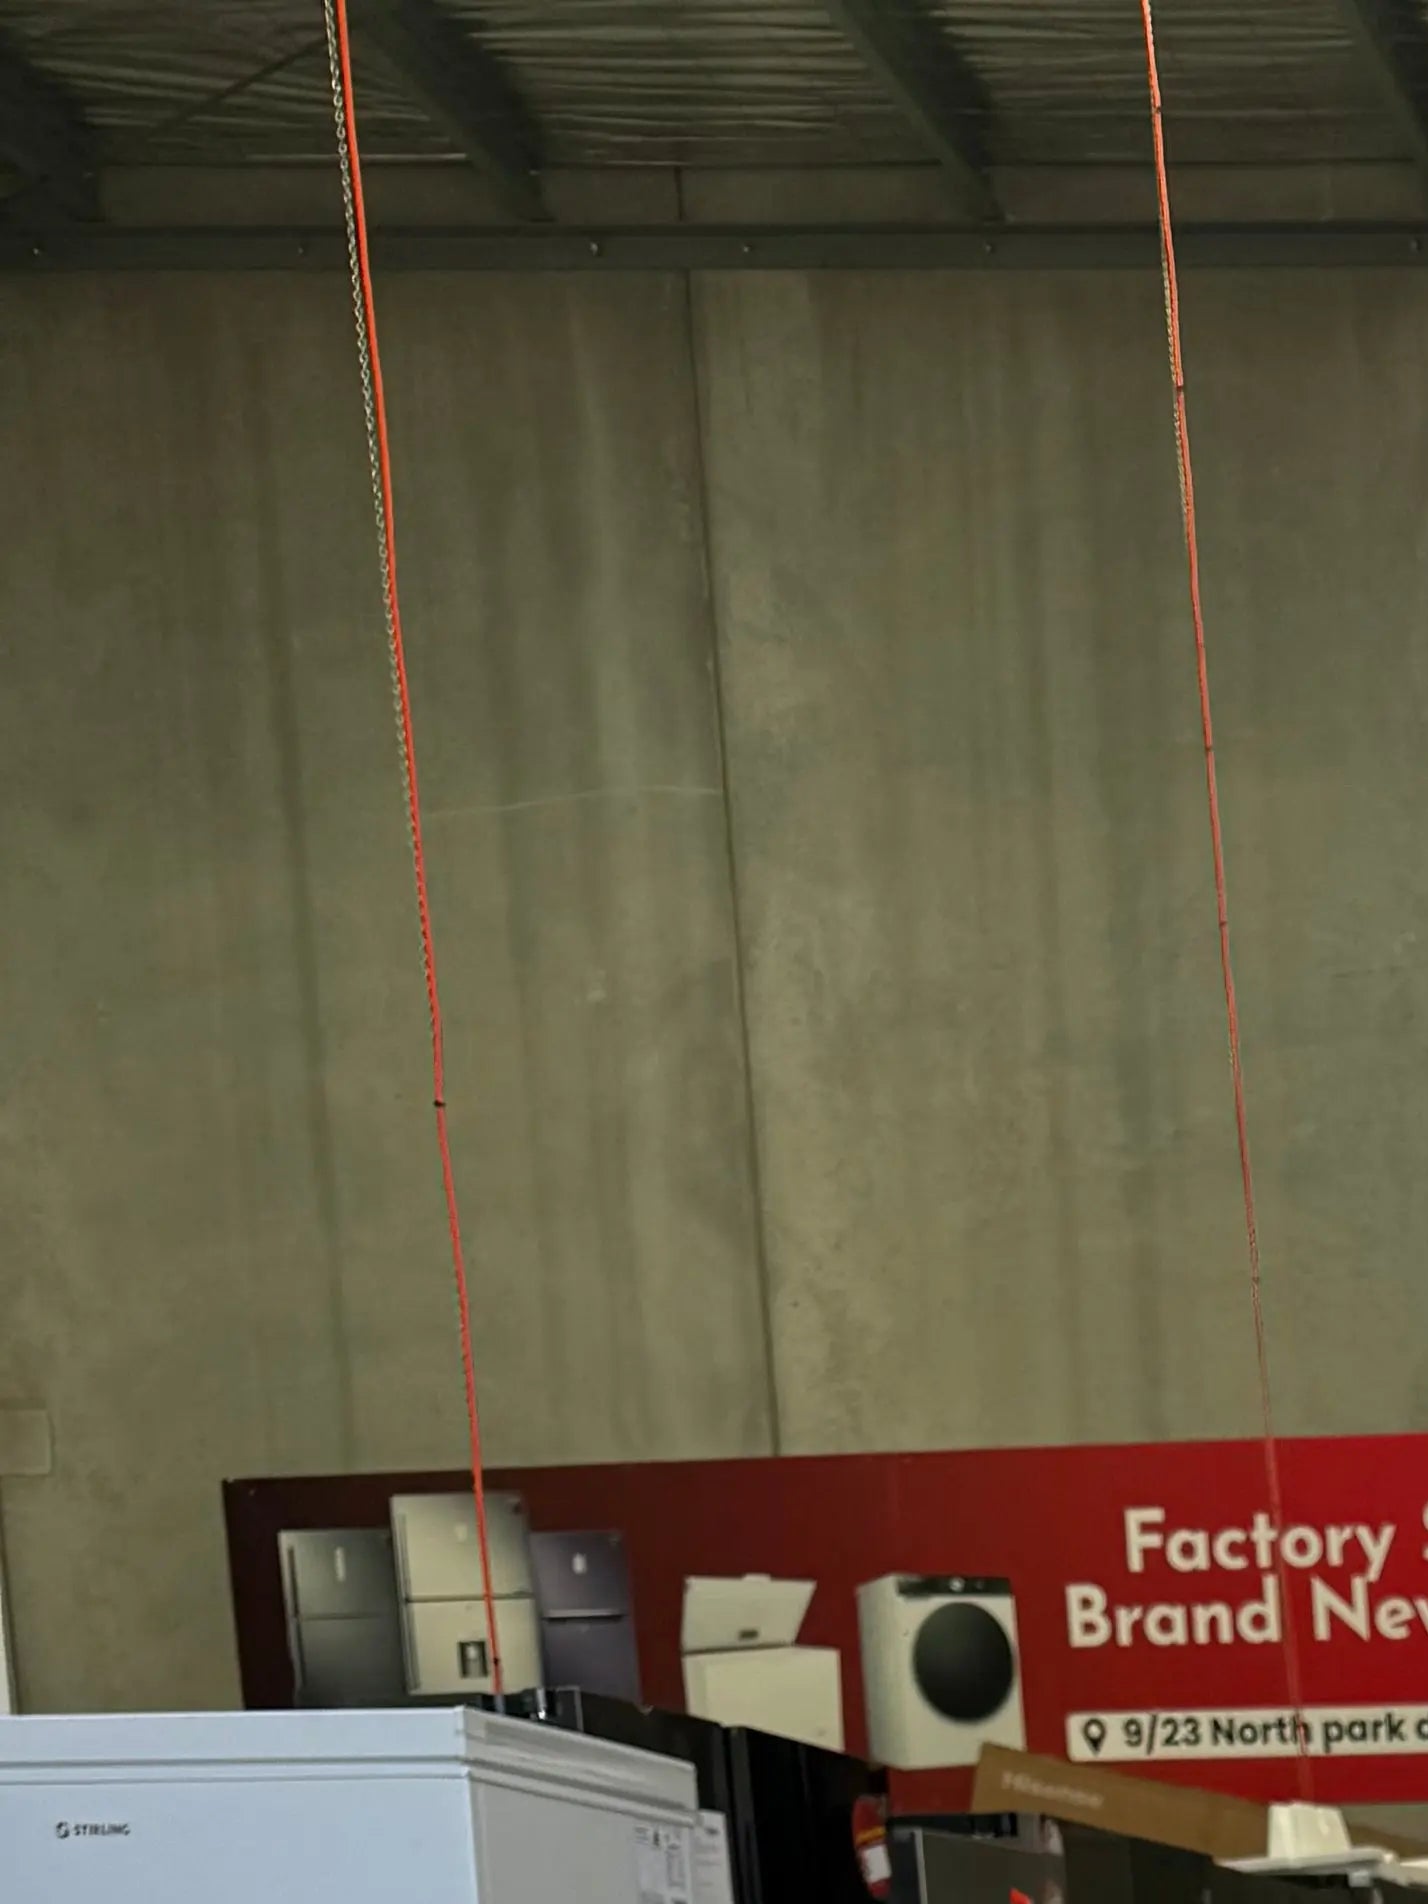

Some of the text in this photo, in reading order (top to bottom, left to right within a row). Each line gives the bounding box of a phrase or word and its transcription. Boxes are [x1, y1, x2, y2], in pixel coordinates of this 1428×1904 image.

[1124, 1506, 1397, 1583] Factory
[1065, 1575, 1282, 1648] Brand
[1123, 1715, 1201, 1755] 9/23
[1211, 1715, 1311, 1747] North
[1323, 1711, 1407, 1753] park
